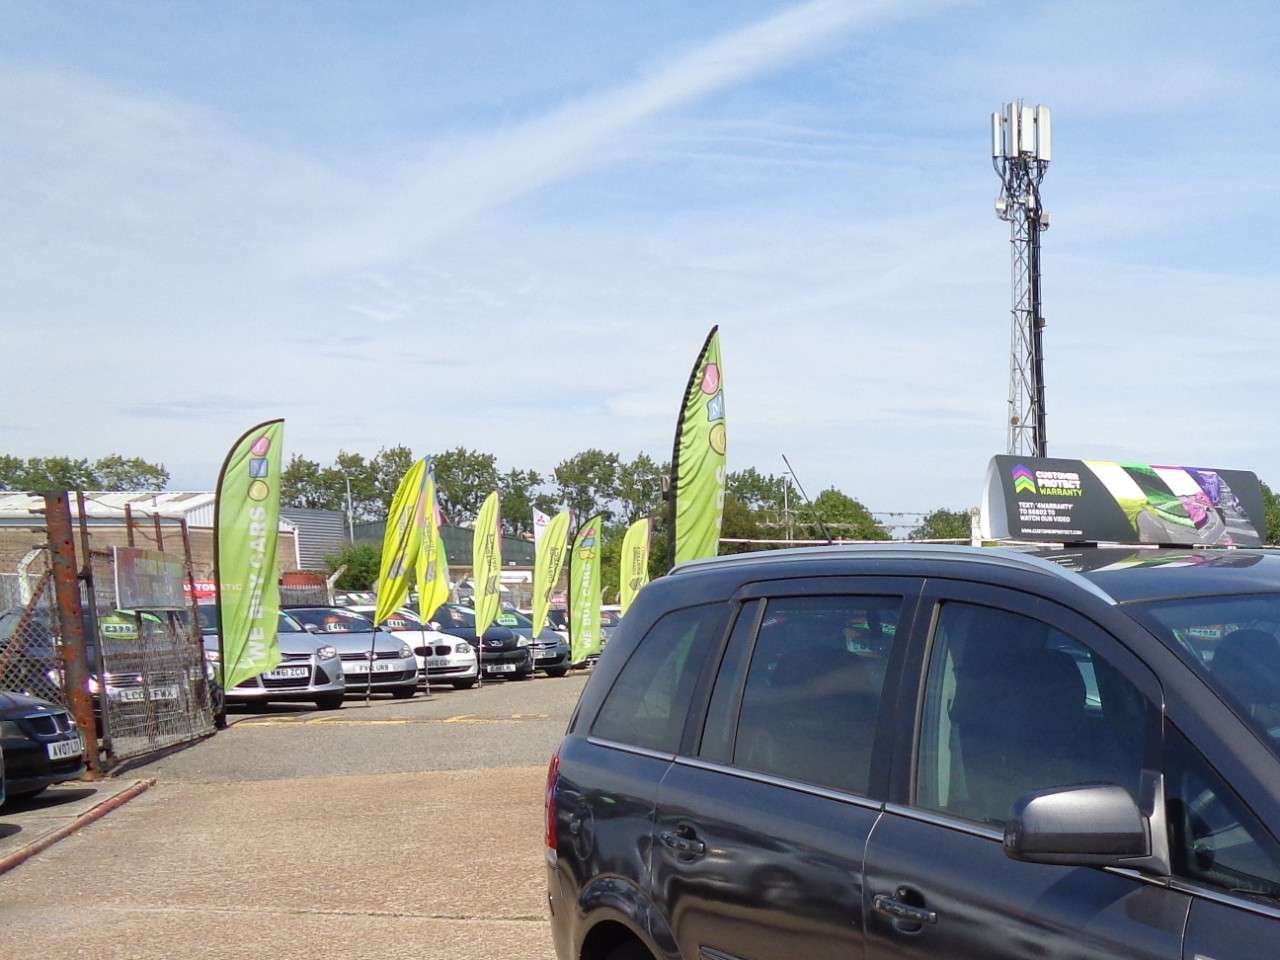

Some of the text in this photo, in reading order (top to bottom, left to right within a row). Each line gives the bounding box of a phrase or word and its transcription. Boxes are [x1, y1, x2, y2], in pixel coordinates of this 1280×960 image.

[1035, 471, 1080, 480] CUSTOMER
[1037, 479, 1080, 488] PROTECT
[1040, 488, 1082, 496] WARRANTY
[247, 506, 267, 668] WE BUY CARS
